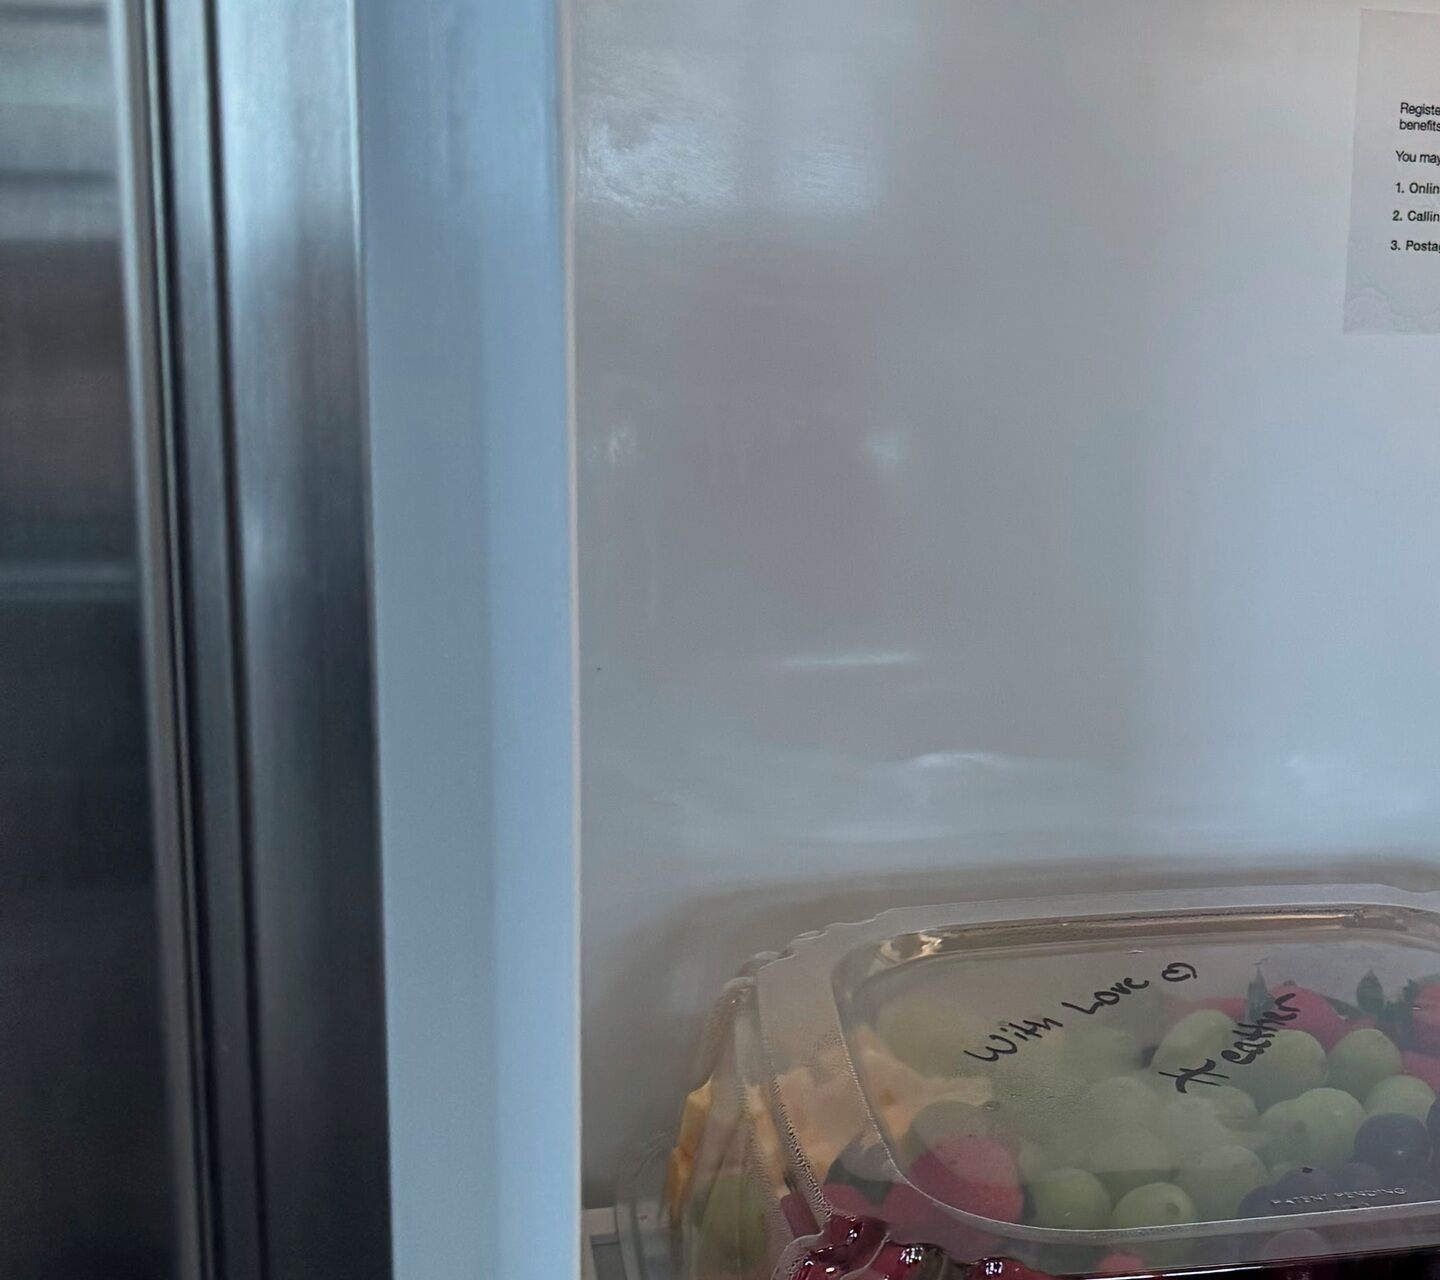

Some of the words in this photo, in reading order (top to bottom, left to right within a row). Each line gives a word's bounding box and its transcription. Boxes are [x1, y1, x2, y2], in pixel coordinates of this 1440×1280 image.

[1396, 150, 1417, 163] You
[1395, 182, 1405, 194] 1.
[1392, 210, 1403, 222] 2.
[1390, 240, 1401, 251] 3.
[963, 1015, 1064, 1064] With
[1061, 974, 1150, 1016] Love
[1158, 992, 1301, 1096] Heather
